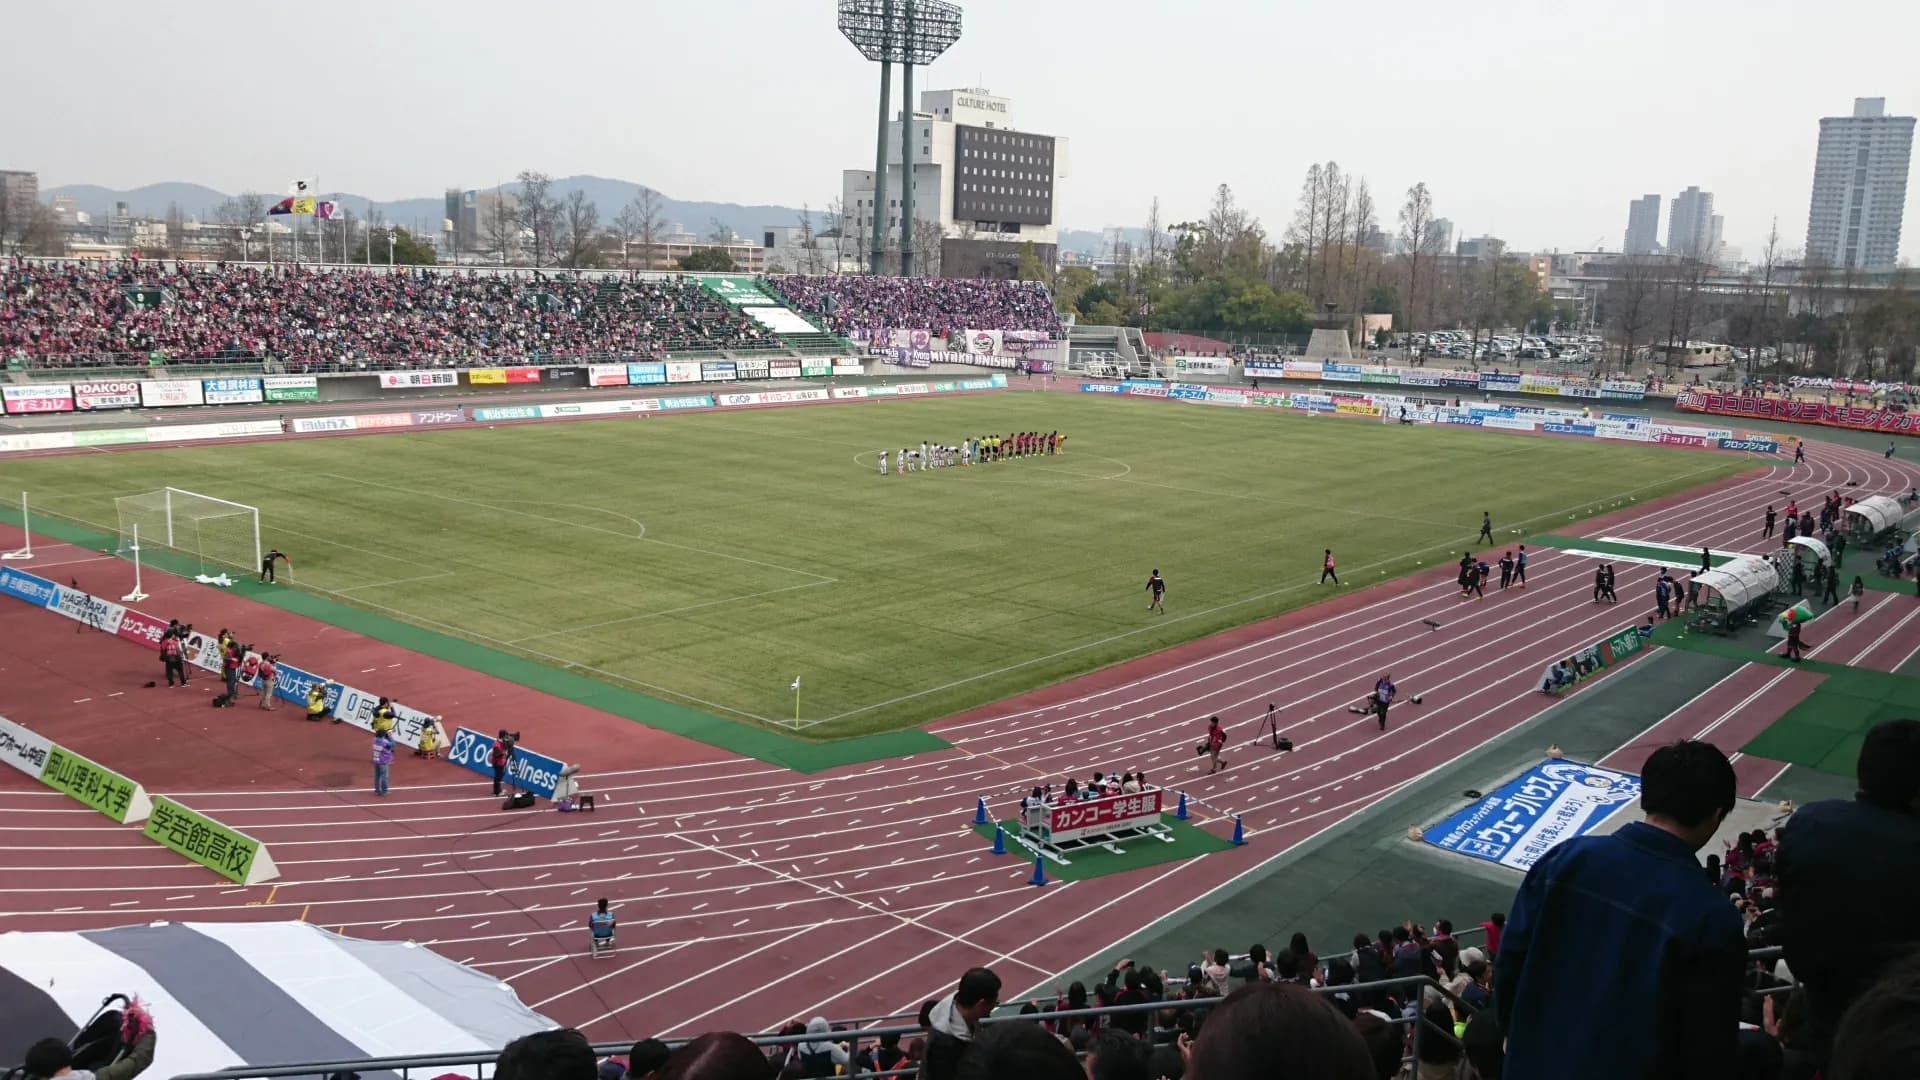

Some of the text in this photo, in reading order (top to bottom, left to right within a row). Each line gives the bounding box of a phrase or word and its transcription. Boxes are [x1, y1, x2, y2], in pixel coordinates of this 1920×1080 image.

[957, 97, 1006, 112] CULTURE HOTEL
[409, 373, 454, 385] 朝日新聞
[1085, 384, 1120, 393] JR西日本
[1676, 391, 1707, 409] 岡山
[1723, 439, 1772, 452] グロップジョイ
[121, 617, 165, 643] カンコー学生
[274, 669, 338, 709] 岡山大学院
[356, 699, 425, 741] 岡大学
[43, 751, 132, 813] 岡山理科大学
[1056, 797, 1156, 829] カンコー学生服
[1474, 776, 1566, 845] ウエーブハウス
[151, 804, 253, 876] 学芸館高校
